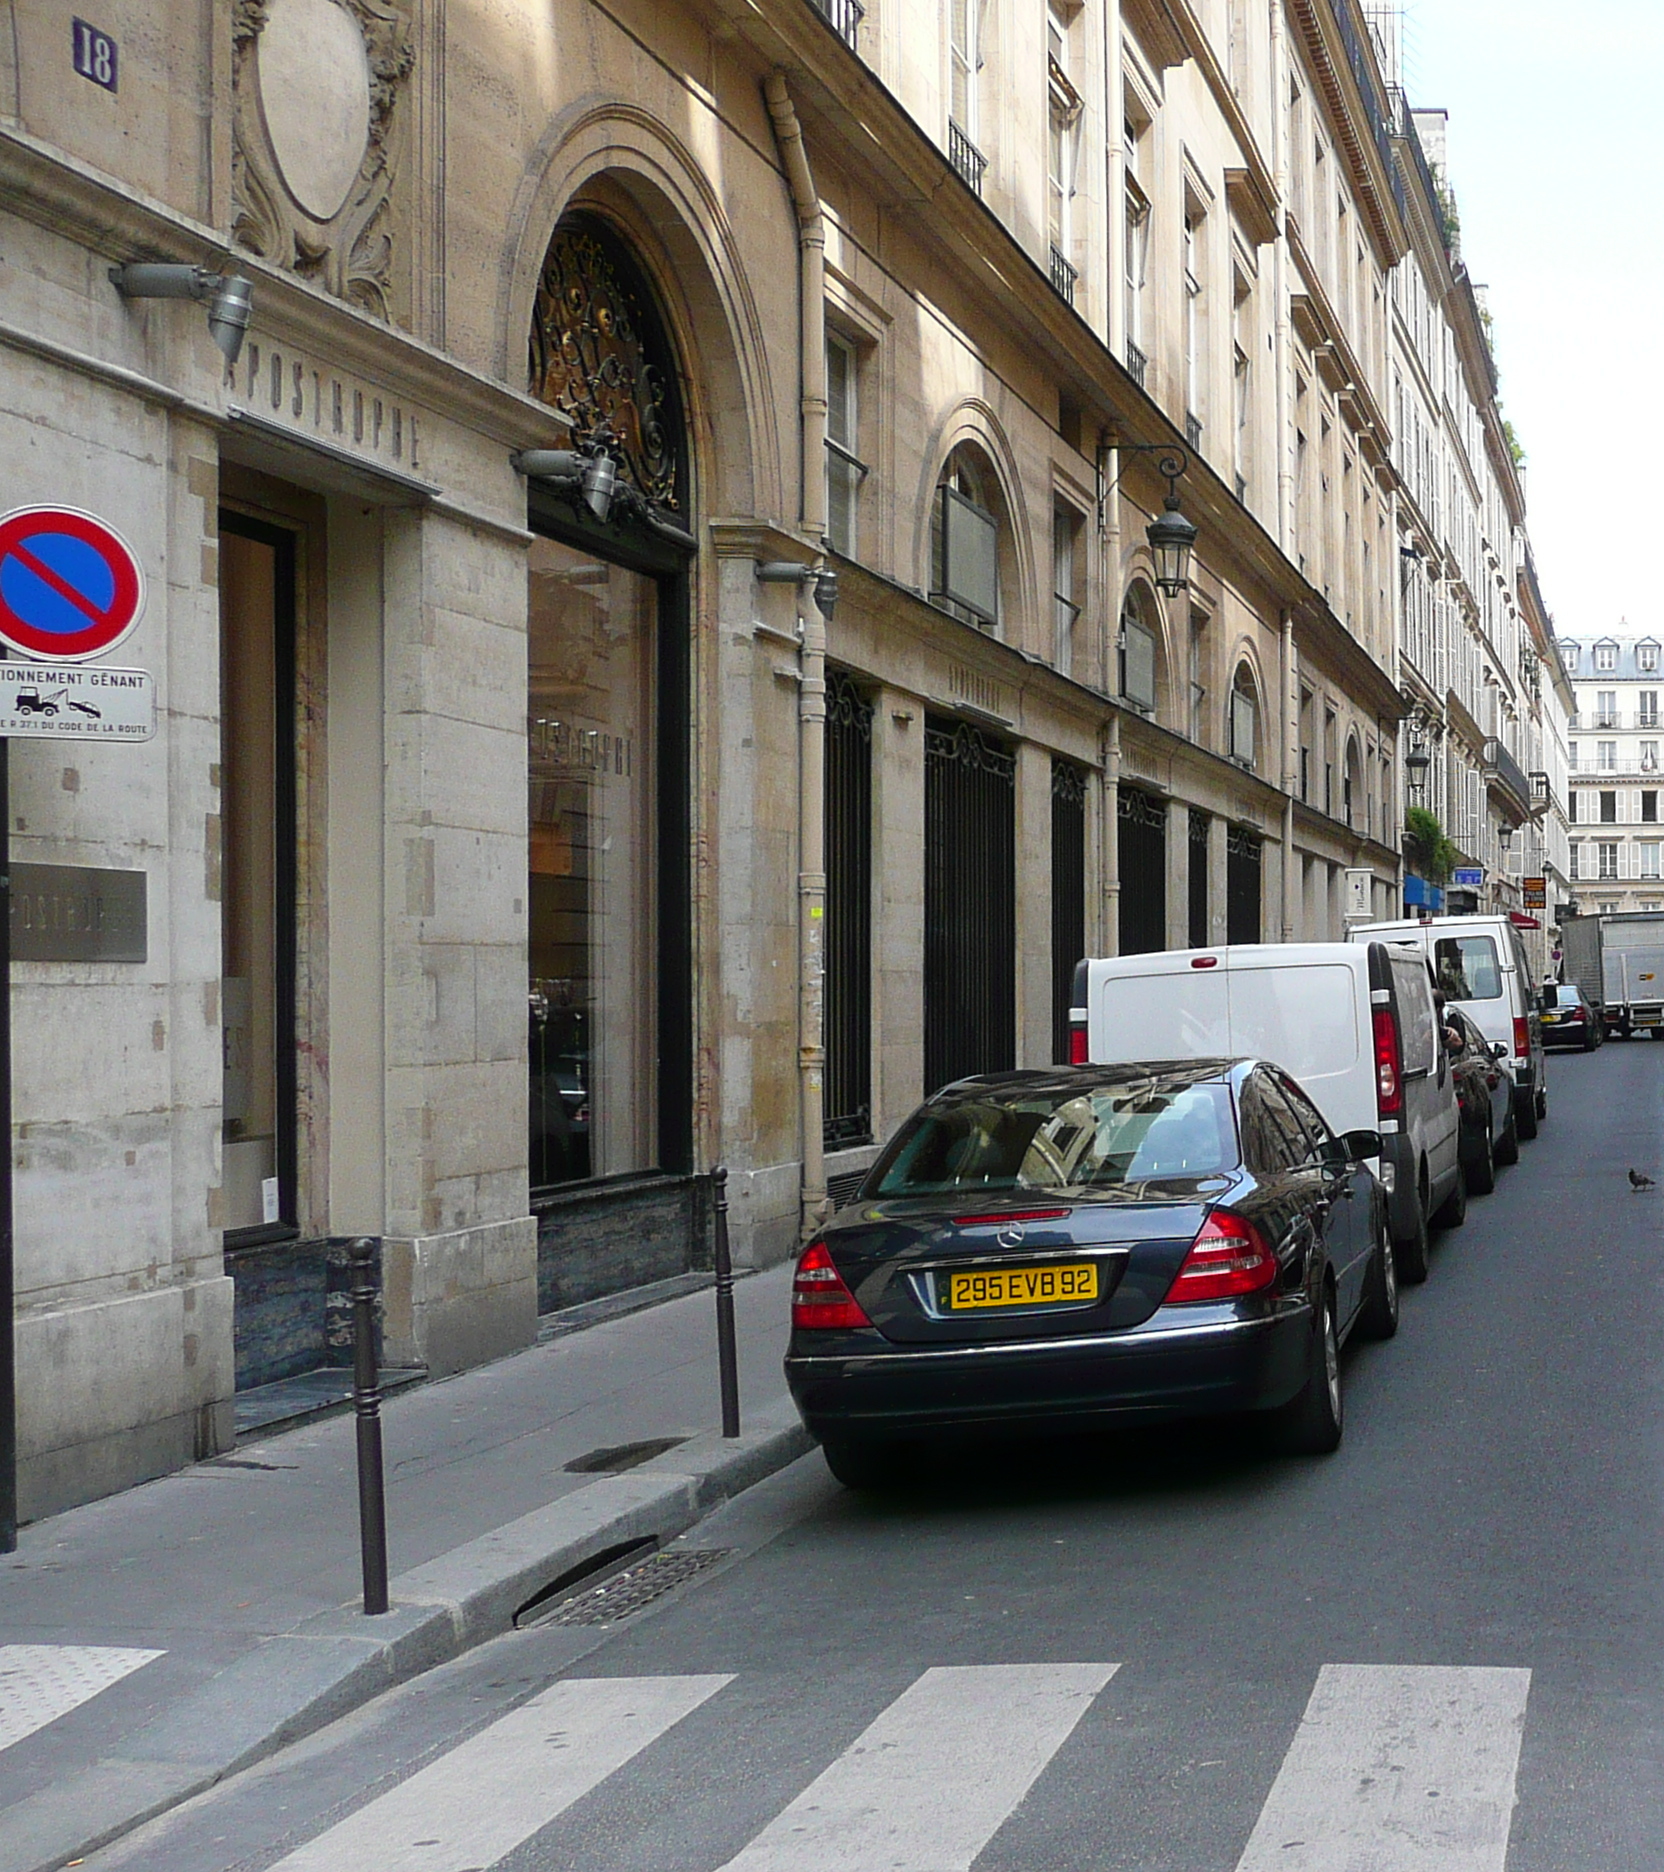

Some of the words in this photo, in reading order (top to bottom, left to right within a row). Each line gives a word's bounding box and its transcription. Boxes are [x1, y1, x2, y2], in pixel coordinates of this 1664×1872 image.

[82, 26, 111, 83] 18
[0, 669, 84, 686] IONNEMENT
[90, 672, 145, 690] GÊNANT
[42, 721, 54, 730] DU
[58, 722, 82, 731] CODE
[87, 723, 99, 731] DE
[103, 723, 114, 732] LA
[118, 724, 147, 734] ROUTE
[956, 1276, 1003, 1303] 295
[1008, 1272, 1055, 1299] EVB
[1061, 1269, 1091, 1295] 92
